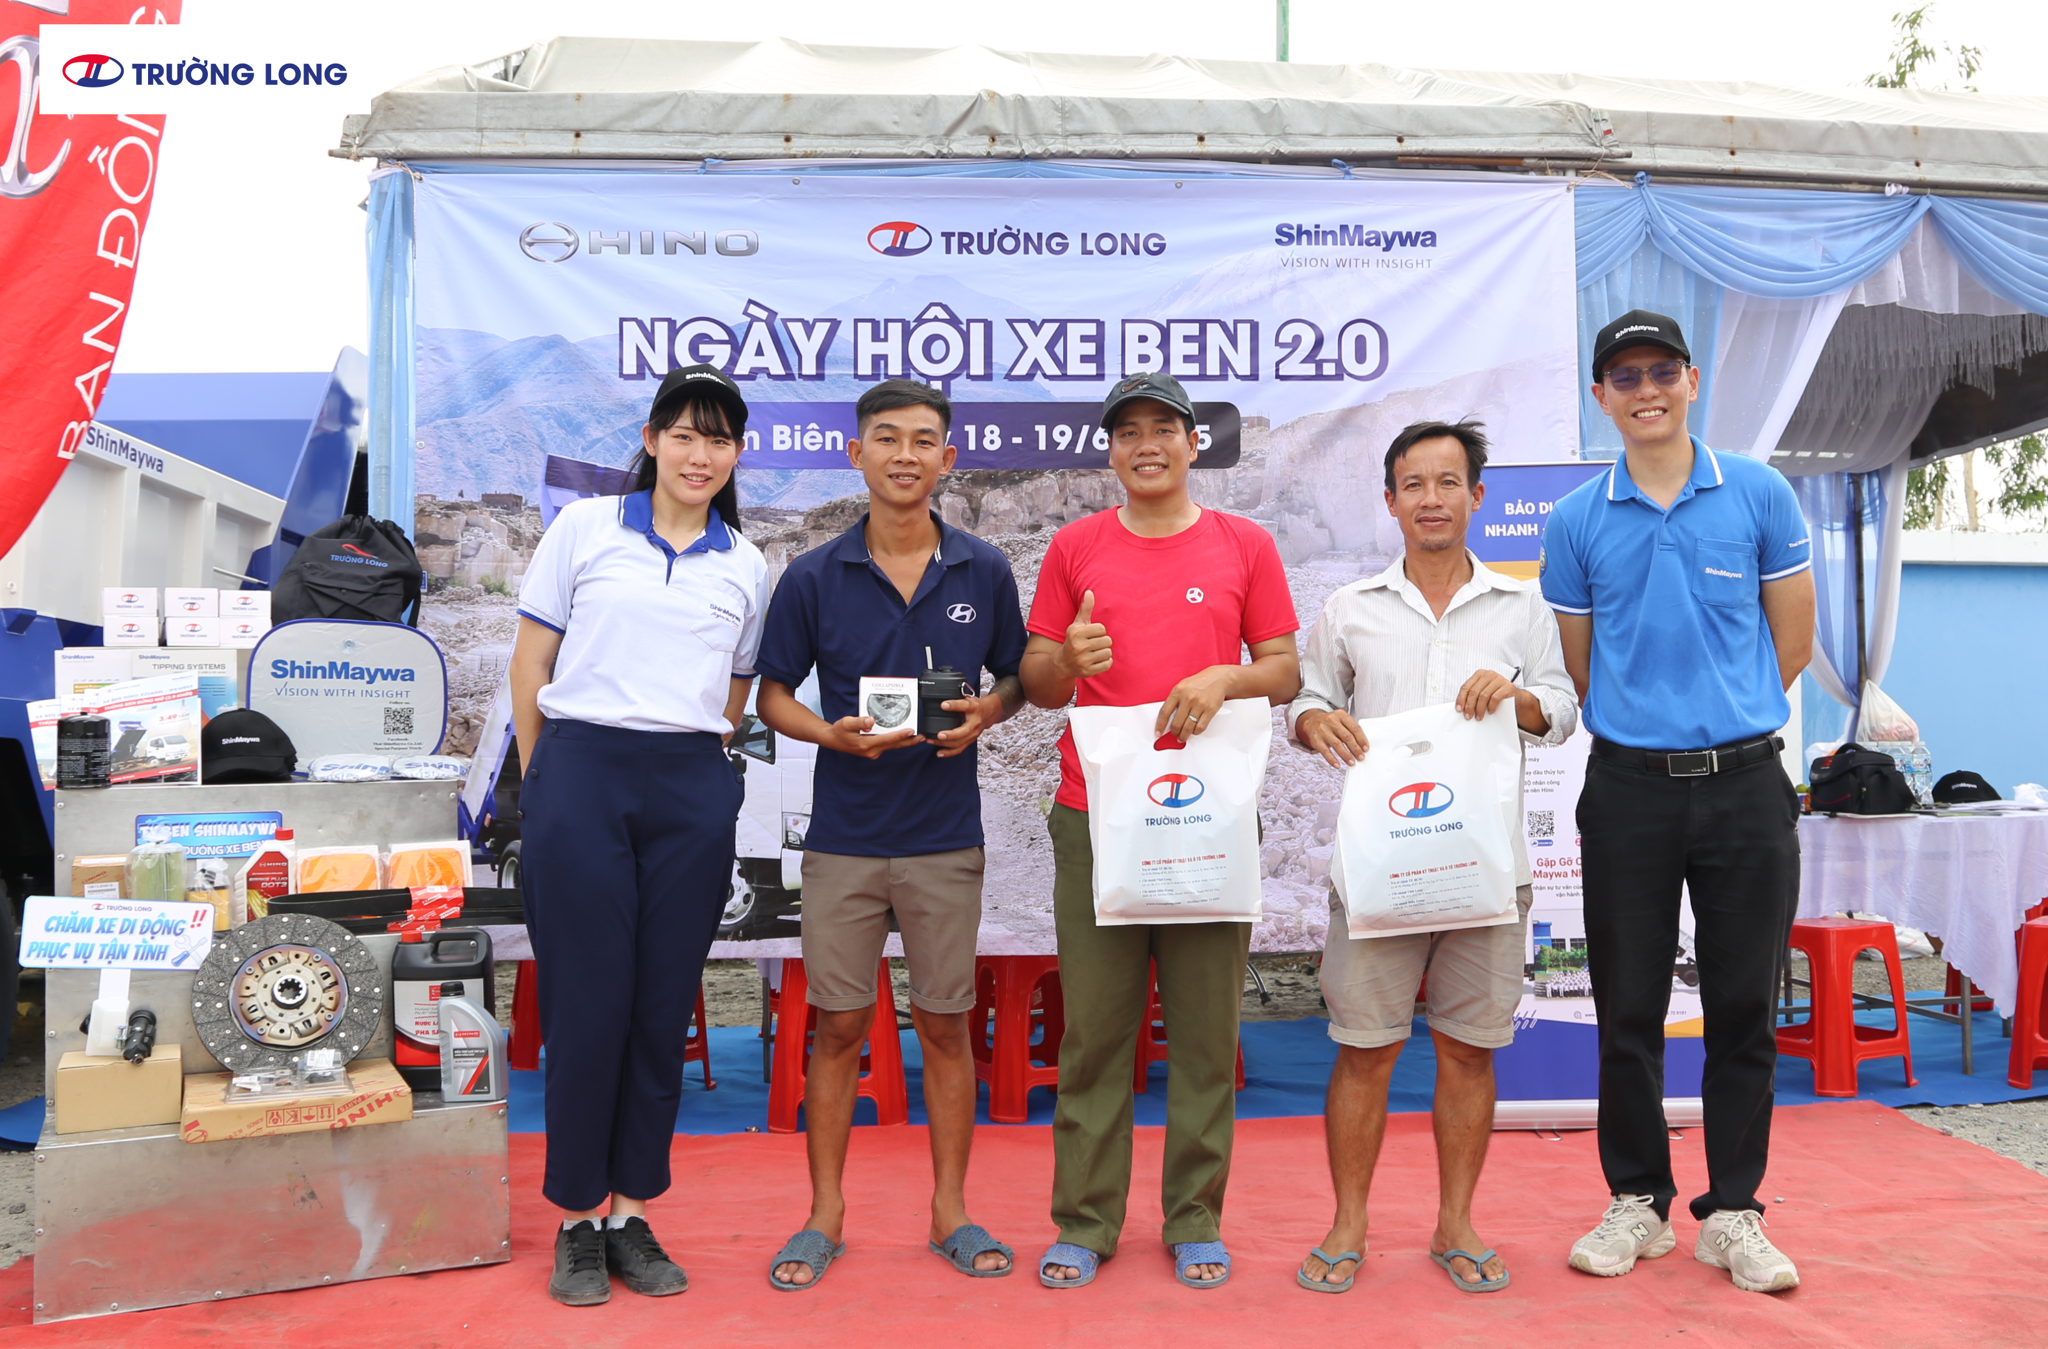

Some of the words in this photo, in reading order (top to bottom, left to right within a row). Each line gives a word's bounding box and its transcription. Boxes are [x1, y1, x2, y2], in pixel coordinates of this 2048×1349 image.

[588, 229, 759, 257] HINO
[941, 224, 1069, 256] TRƯỜNG
[1081, 232, 1167, 256] LONG
[1275, 222, 1437, 252] ShinMaywa
[1281, 255, 1329, 268] VISION
[1335, 258, 1370, 269] WITH
[1376, 258, 1433, 270] INSIGHT
[1615, 325, 1659, 339] ShinMaywa
[618, 298, 841, 381] NGÀY
[853, 302, 992, 396] HỘI
[1007, 318, 1104, 382] XE
[1120, 318, 1259, 382] BEN
[1274, 317, 1389, 382] 2.0
[964, 424, 1001, 451] 18
[86, 425, 164, 474] ShinMaywa
[1505, 499, 1535, 515] BẢO
[1485, 523, 1538, 537] NHANH
[366, 559, 388, 568] LONG
[1705, 567, 1742, 578] ShinMaywa
[271, 659, 415, 684] ShinMaywa
[275, 684, 319, 697] VISION
[324, 688, 355, 698] WITH
[360, 689, 411, 699] INSIGHT
[159, 713, 178, 722] 3.49
[221, 736, 260, 744] ShinMaywa
[1145, 815, 1181, 826] TRƯỜNG
[1183, 814, 1212, 825] LONG
[193, 821, 278, 838] SHINMAYWA
[1389, 825, 1432, 839] TRƯỜNG
[1435, 821, 1463, 833] LONG
[225, 843, 240, 854] XE
[1536, 857, 1556, 868] Gặp
[1559, 856, 1573, 866] Gỡ
[106, 904, 133, 912] TRƯỜNG
[44, 911, 94, 934] CHĂM
[95, 917, 118, 934] XE
[119, 917, 137, 935] DI
[139, 912, 187, 940] ĐỘNG
[26, 941, 71, 963] PHỤC
[73, 942, 95, 964] VỤ
[98, 938, 130, 964] TẬN
[133, 938, 170, 962] TÌNH
